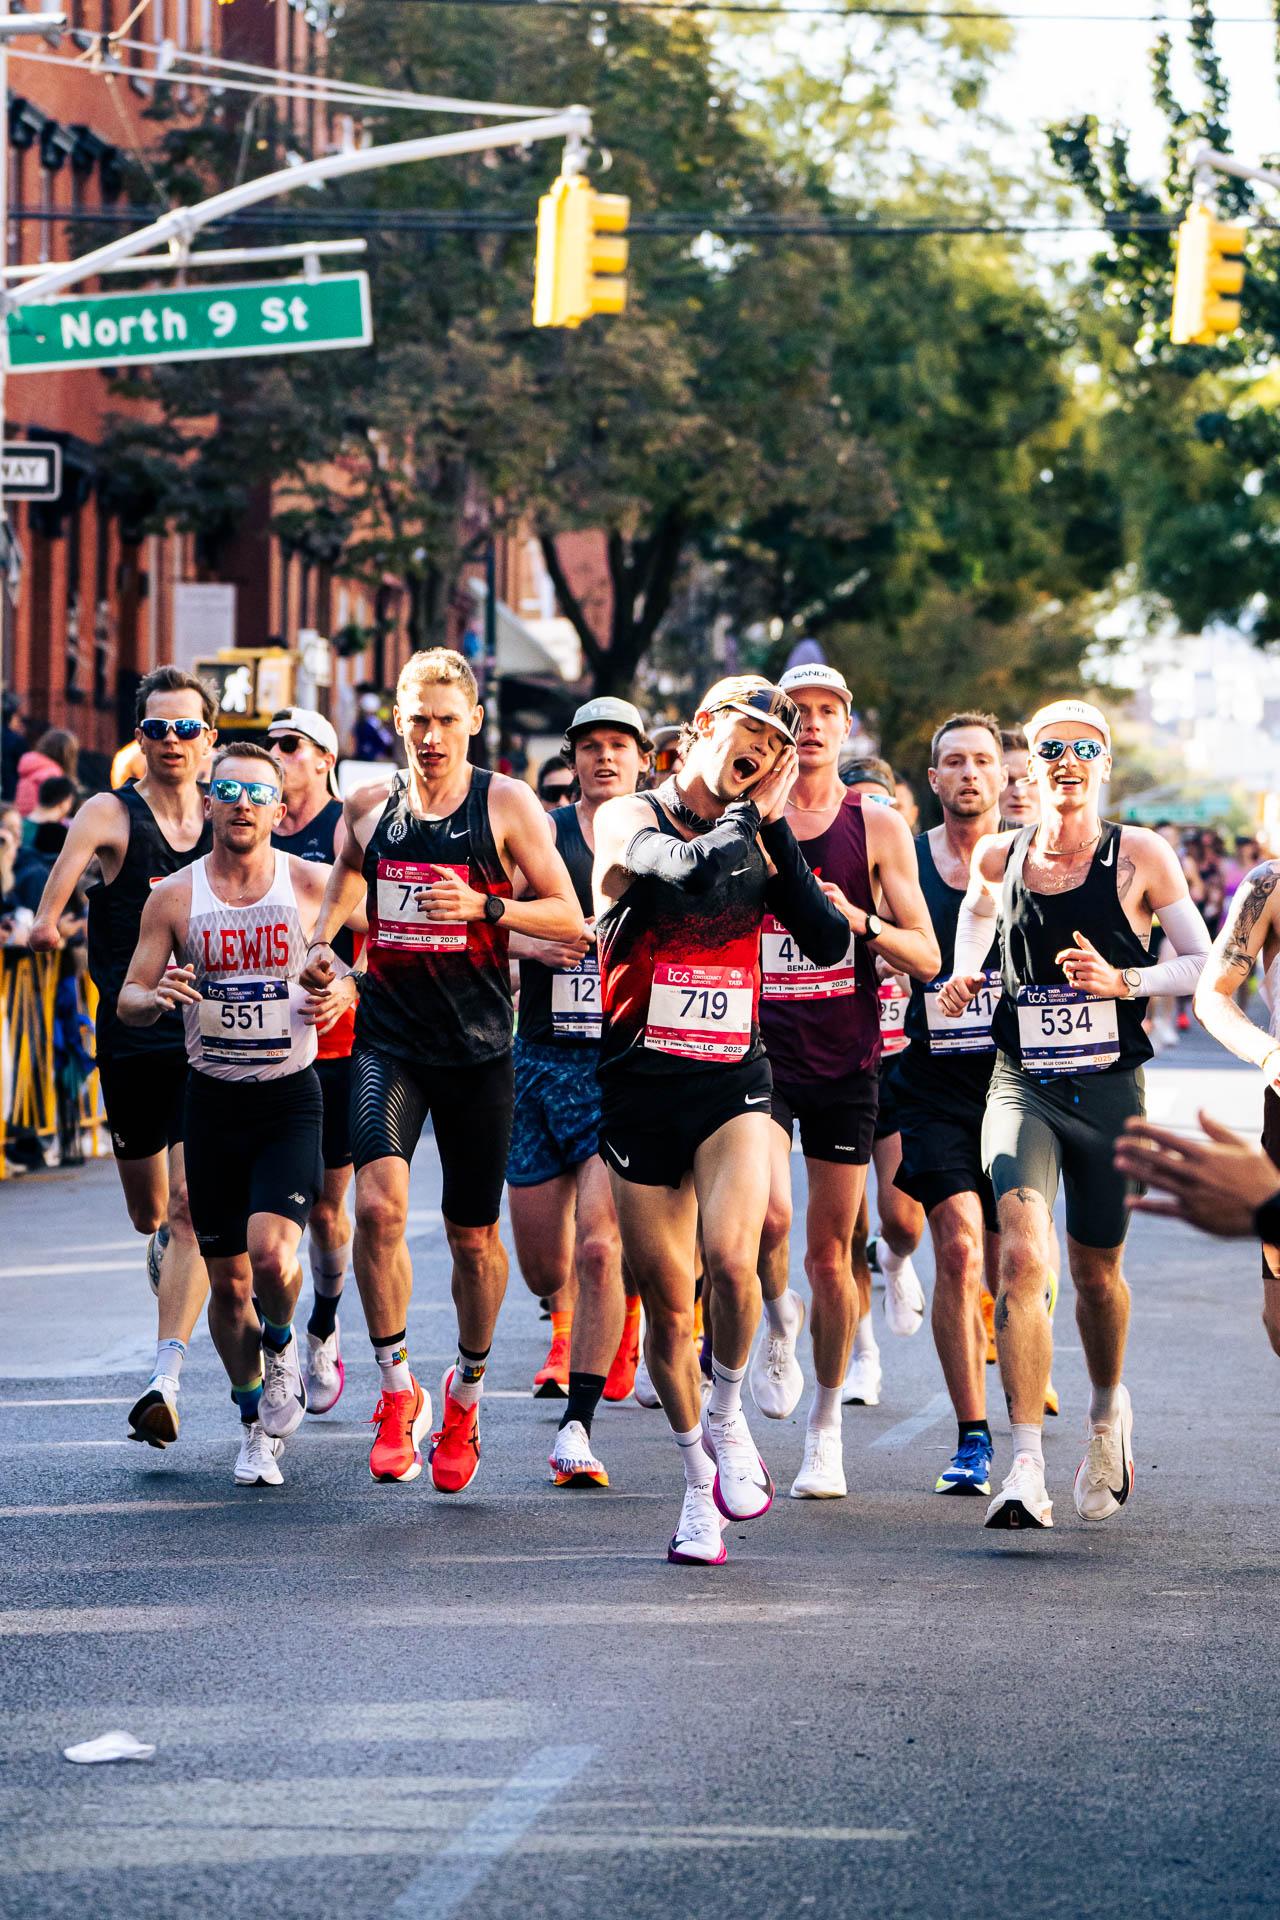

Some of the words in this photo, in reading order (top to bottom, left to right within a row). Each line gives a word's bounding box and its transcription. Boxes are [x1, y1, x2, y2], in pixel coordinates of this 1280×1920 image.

[60, 307, 187, 350] North
[208, 301, 237, 338] 9
[260, 296, 309, 334] St
[385, 864, 404, 879] tcs
[398, 885, 433, 912] 71
[202, 923, 289, 972] LEWIS
[667, 968, 690, 984] tcs
[831, 980, 848, 988] 2025
[208, 985, 225, 999] tcs
[570, 977, 602, 1002] 12
[1027, 990, 1047, 1003] tcs
[221, 1004, 263, 1029] 551
[680, 989, 728, 1020] 719
[1041, 1006, 1093, 1036] 534
[1093, 1055, 1112, 1063] 2025
